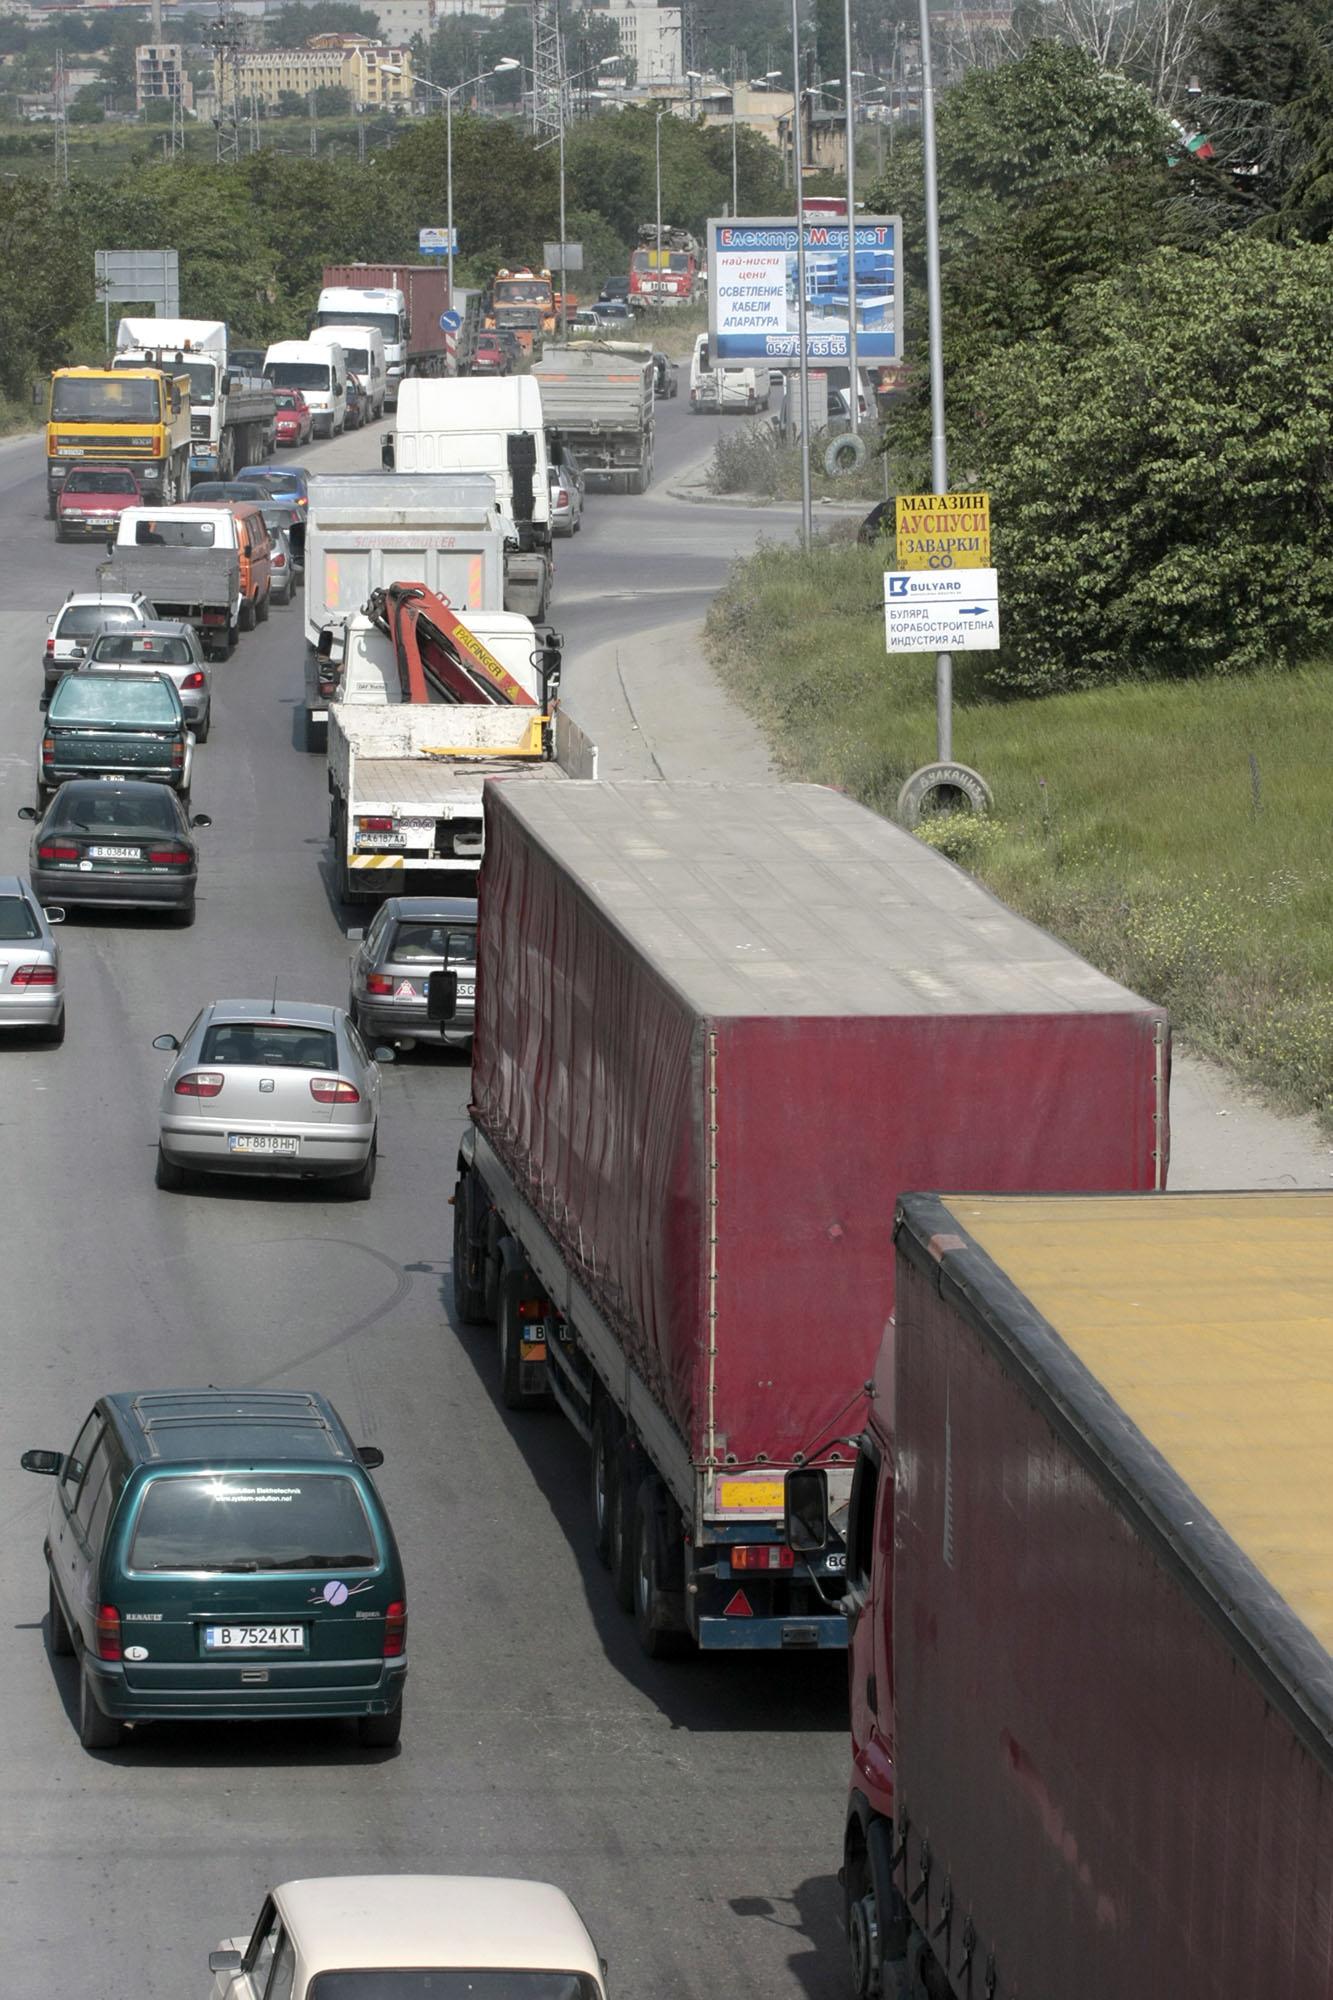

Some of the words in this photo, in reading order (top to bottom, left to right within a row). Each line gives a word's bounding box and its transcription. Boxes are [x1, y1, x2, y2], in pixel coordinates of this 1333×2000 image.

[738, 272, 767, 280] цени
[719, 286, 784, 297] ОСВЕТЛЕНИЕ
[731, 301, 771, 311] КАБЕЛИ
[723, 316, 779, 326] АПАРАТУРА
[814, 343, 828, 354] 55
[831, 342, 845, 354] 55
[902, 496, 984, 511] МАГАЗИН
[900, 513, 987, 534] АУСПУСИ
[906, 537, 979, 553] ЗАВАРКИ
[910, 582, 961, 592] BULYARD
[890, 609, 929, 620] БУЛЯРД
[890, 621, 994, 632] КОРАБОСТРОИТЕЛНА
[890, 635, 948, 647] ИНДУСТРИЯ
[951, 634, 965, 645] АД
[455, 628, 502, 677] PALFINGER
